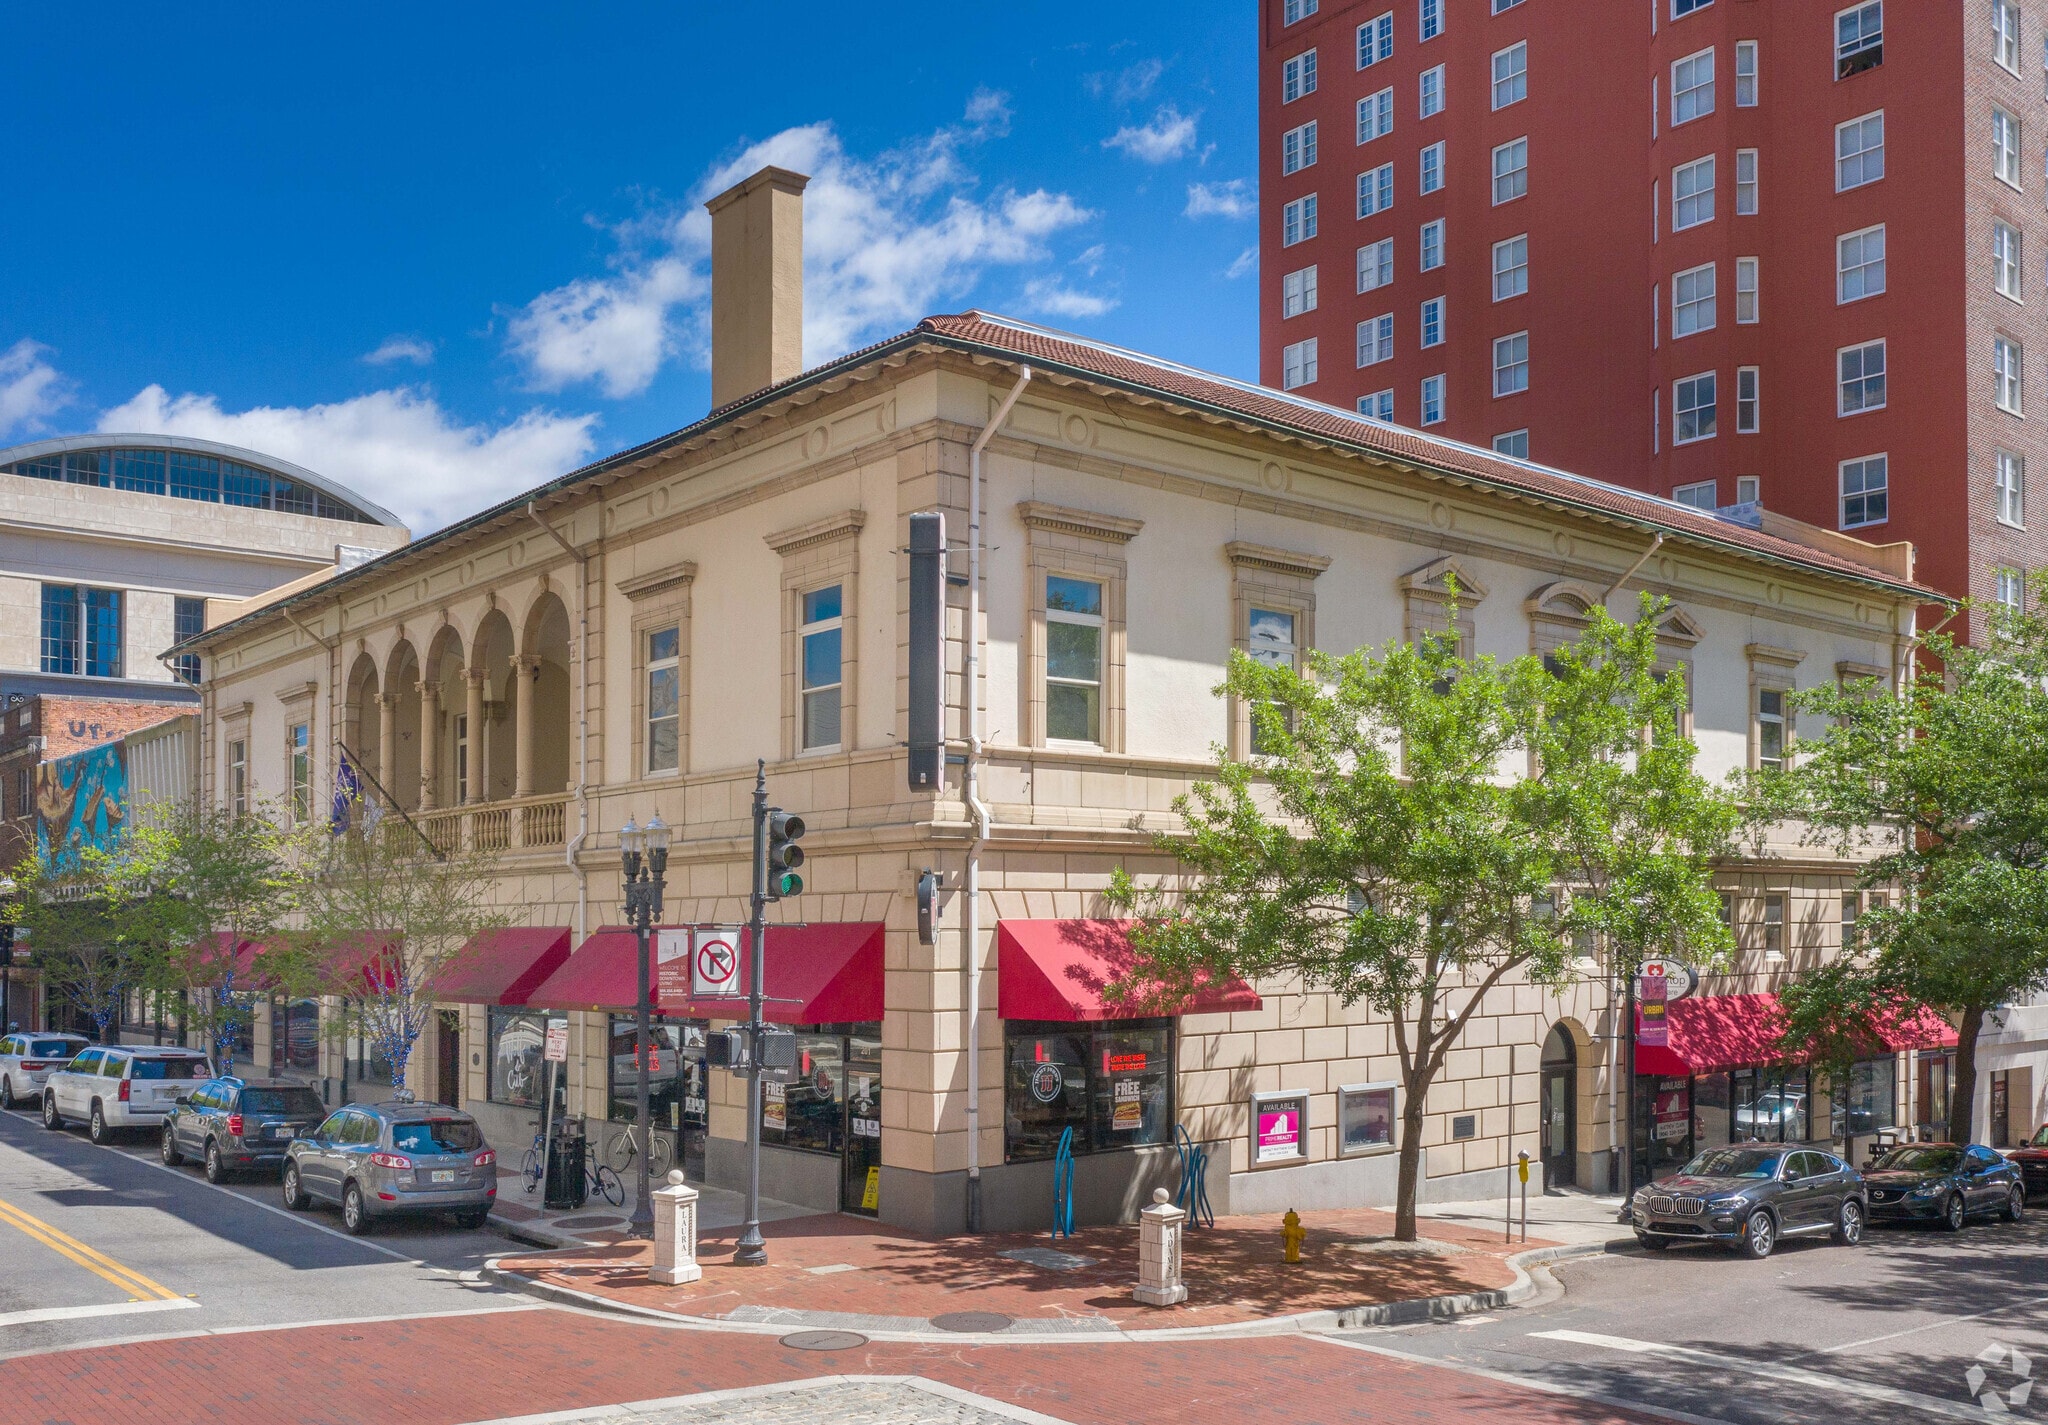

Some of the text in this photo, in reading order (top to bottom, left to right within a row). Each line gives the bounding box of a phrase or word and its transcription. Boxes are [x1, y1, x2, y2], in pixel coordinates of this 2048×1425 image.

[860, 1046, 871, 1056] 201
[507, 1069, 529, 1090] Cub
[766, 1081, 786, 1096] FREE
[1114, 1081, 1140, 1096] FREE
[1660, 1080, 1687, 1091] AVAILABLE
[1114, 1094, 1140, 1103] SANDWICH
[1262, 1102, 1296, 1112] AVAILABLE
